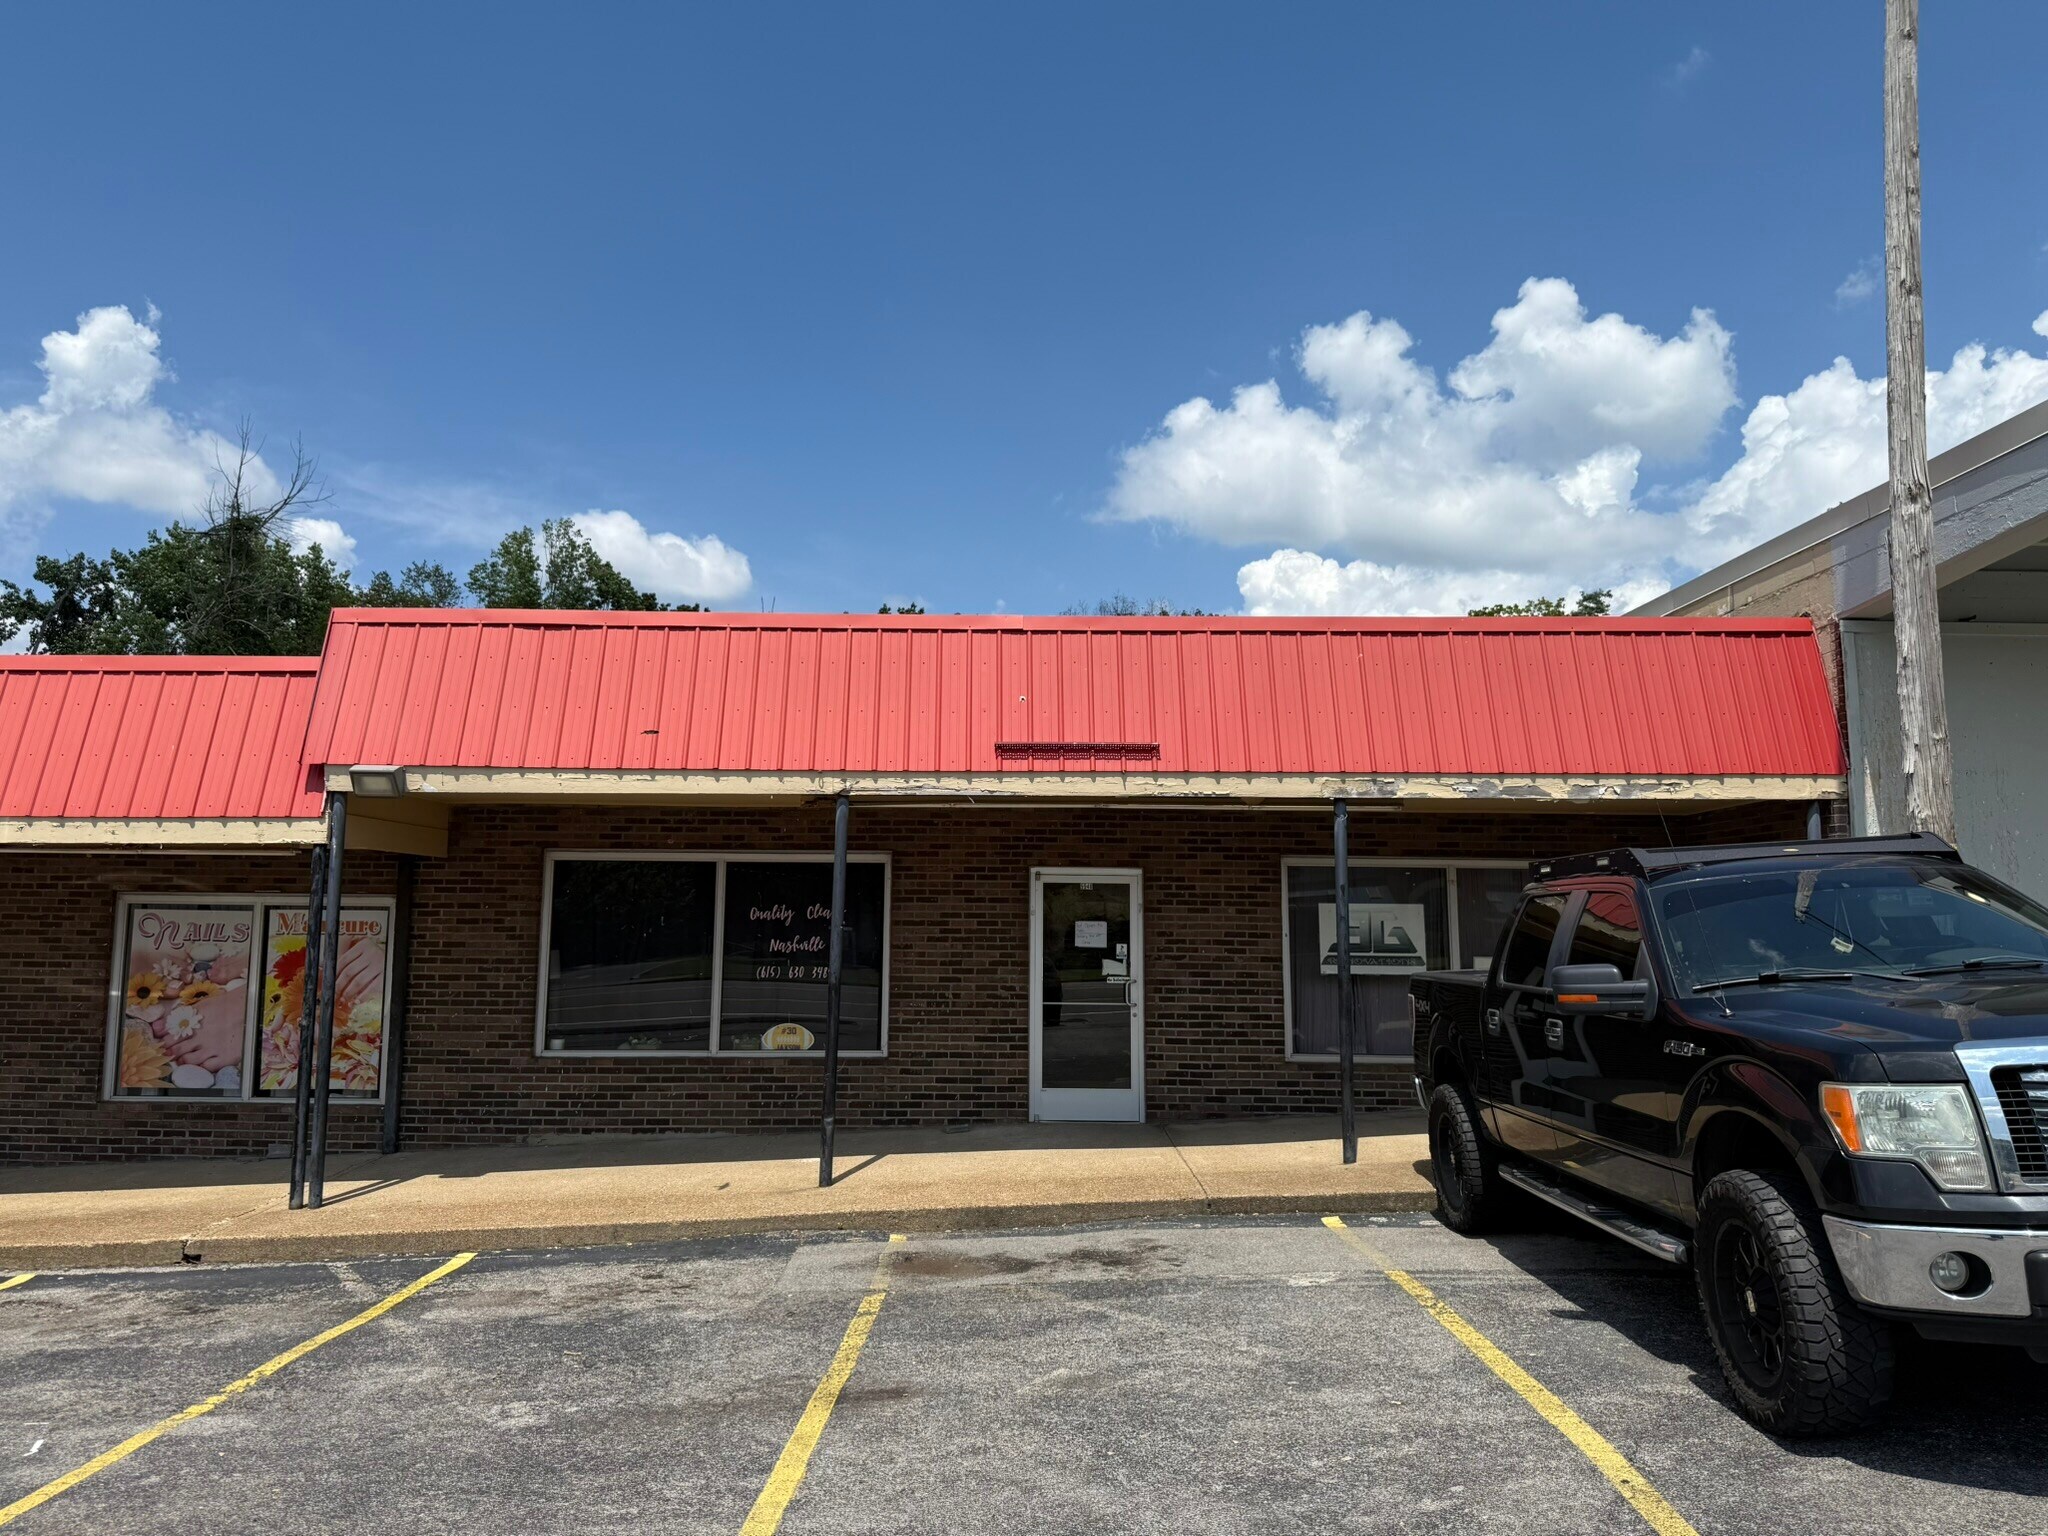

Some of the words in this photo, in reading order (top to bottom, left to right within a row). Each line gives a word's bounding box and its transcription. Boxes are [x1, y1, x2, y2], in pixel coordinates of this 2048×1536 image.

[750, 904, 795, 926] Quality
[769, 935, 825, 953] Nashville
[756, 965, 781, 979] (615)
[788, 966, 805, 979] 630
[781, 1027, 797, 1035] #30
